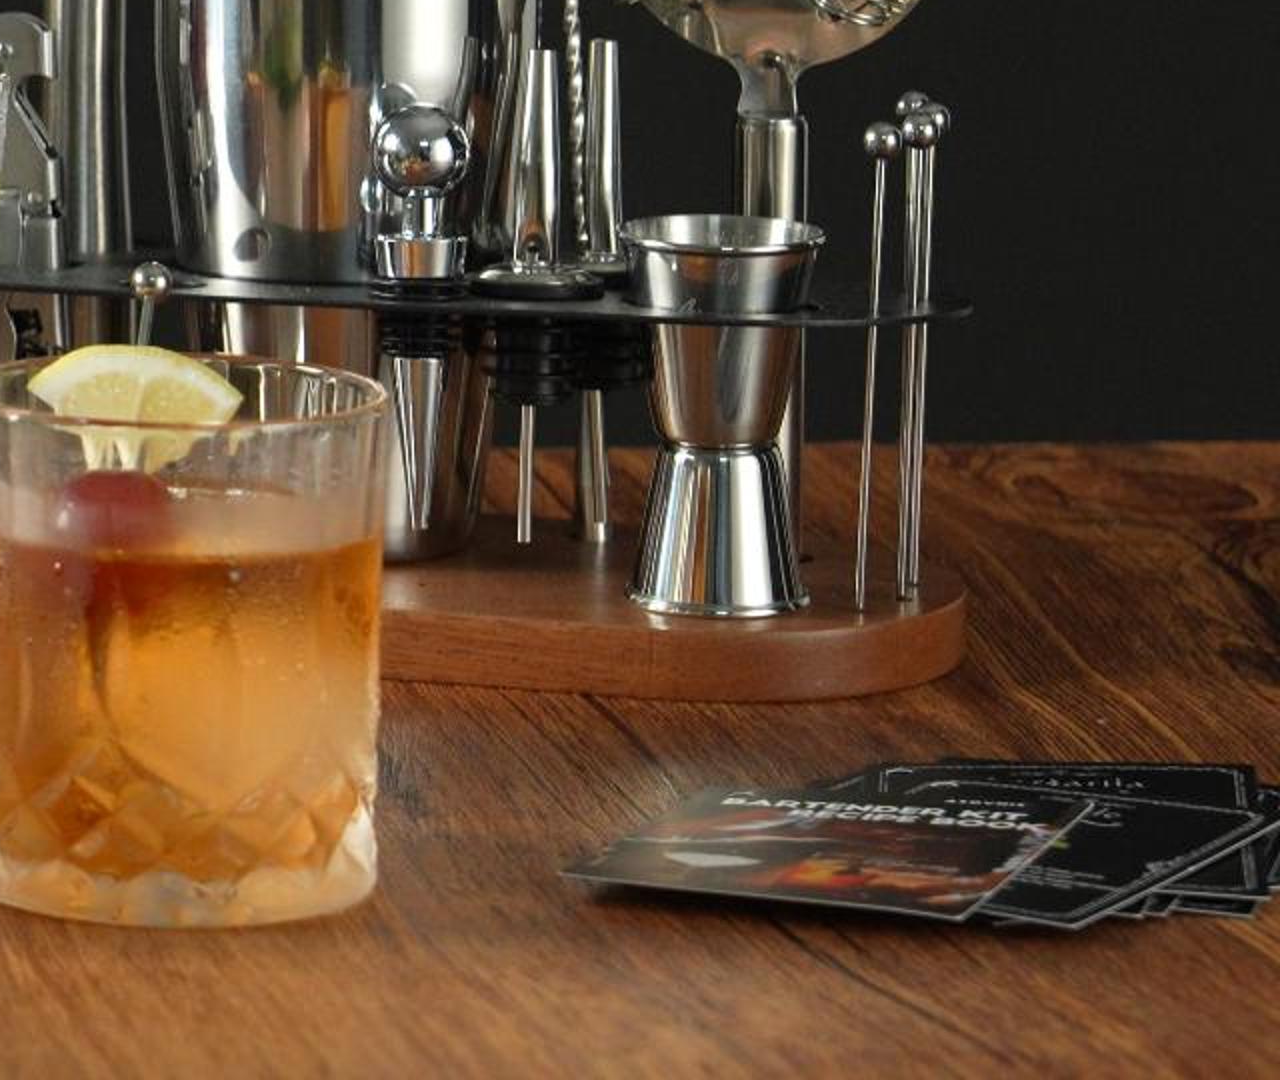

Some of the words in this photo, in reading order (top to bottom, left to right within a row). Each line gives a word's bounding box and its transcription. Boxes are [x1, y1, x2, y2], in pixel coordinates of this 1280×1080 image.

[721, 797, 946, 817] BARTENDER
[958, 809, 1029, 822] KIT
[787, 808, 921, 824] RECIPE
[930, 817, 1053, 835] BOOK
